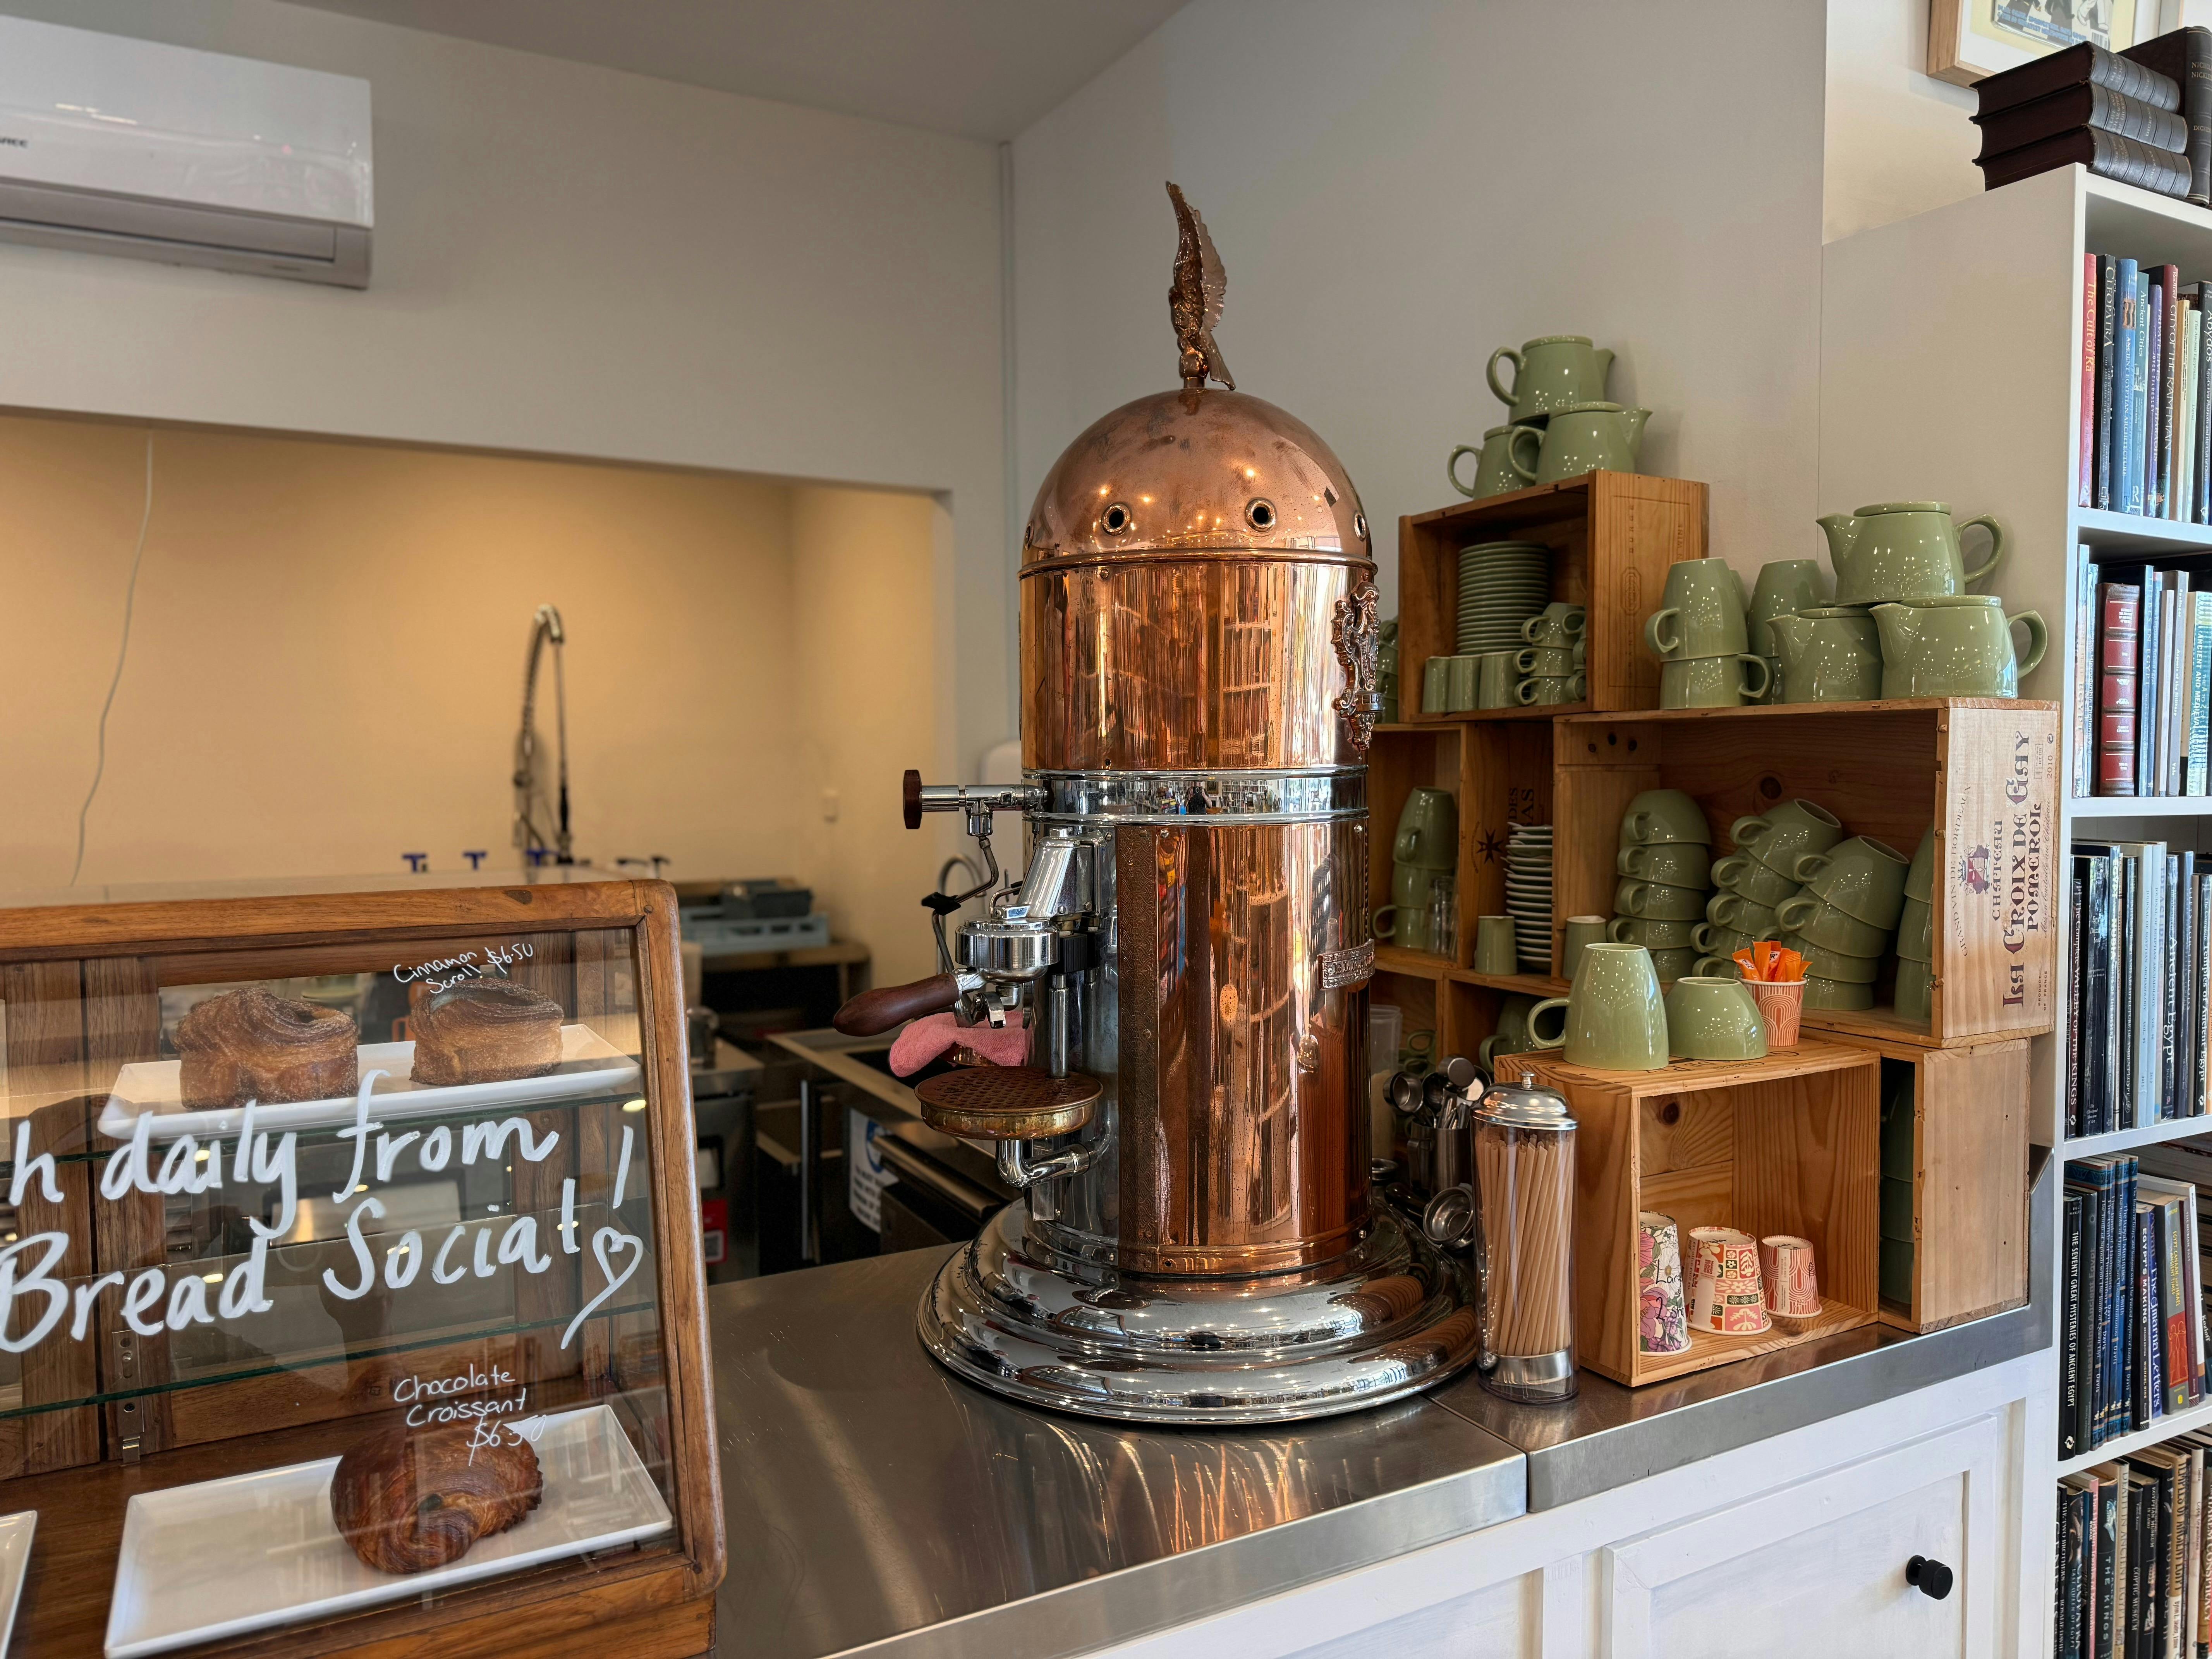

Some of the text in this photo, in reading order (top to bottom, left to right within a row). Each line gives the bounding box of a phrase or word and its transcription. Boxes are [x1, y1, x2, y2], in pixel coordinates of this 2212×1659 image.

[2104, 266, 2116, 347] CLEOPATRA
[2085, 283, 2095, 372] The Cult of Ra
[2169, 333, 2176, 347] OF
[2203, 310, 2212, 362] Abydos
[2165, 376, 2174, 450] RAM-MAN
[2193, 691, 2201, 728] MEDIEVAL
[2201, 694, 2205, 702] TO
[1508, 787, 1518, 819] DES
[1951, 783, 1971, 854] BORDEAUX
[1950, 860, 1956, 879] DE
[2027, 803, 2042, 931] POMEROL
[1953, 911, 1969, 957] GRAND
[394, 944, 533, 982] Cinnamon $6.50
[426, 963, 481, 994] Scroll
[2043, 1000, 2047, 1011] OF
[2163, 936, 2178, 1064] Ancient Egypt
[2202, 991, 2208, 1001] of
[2073, 1020, 2078, 1033] OF
[2199, 1051, 2207, 1082] Egypt
[9, 1069, 560, 1239] h daily from
[0, 1231, 274, 1353] Bread
[2068, 1342, 2076, 1352] OF
[394, 1364, 515, 1402] Chocolate
[2152, 1352, 2161, 1407] Letters
[407, 1388, 526, 1426] Croissant
[2121, 1514, 2128, 1526] IN
[2174, 1462, 2187, 1591] TEMPLES OF ANCIENT EGYPT
